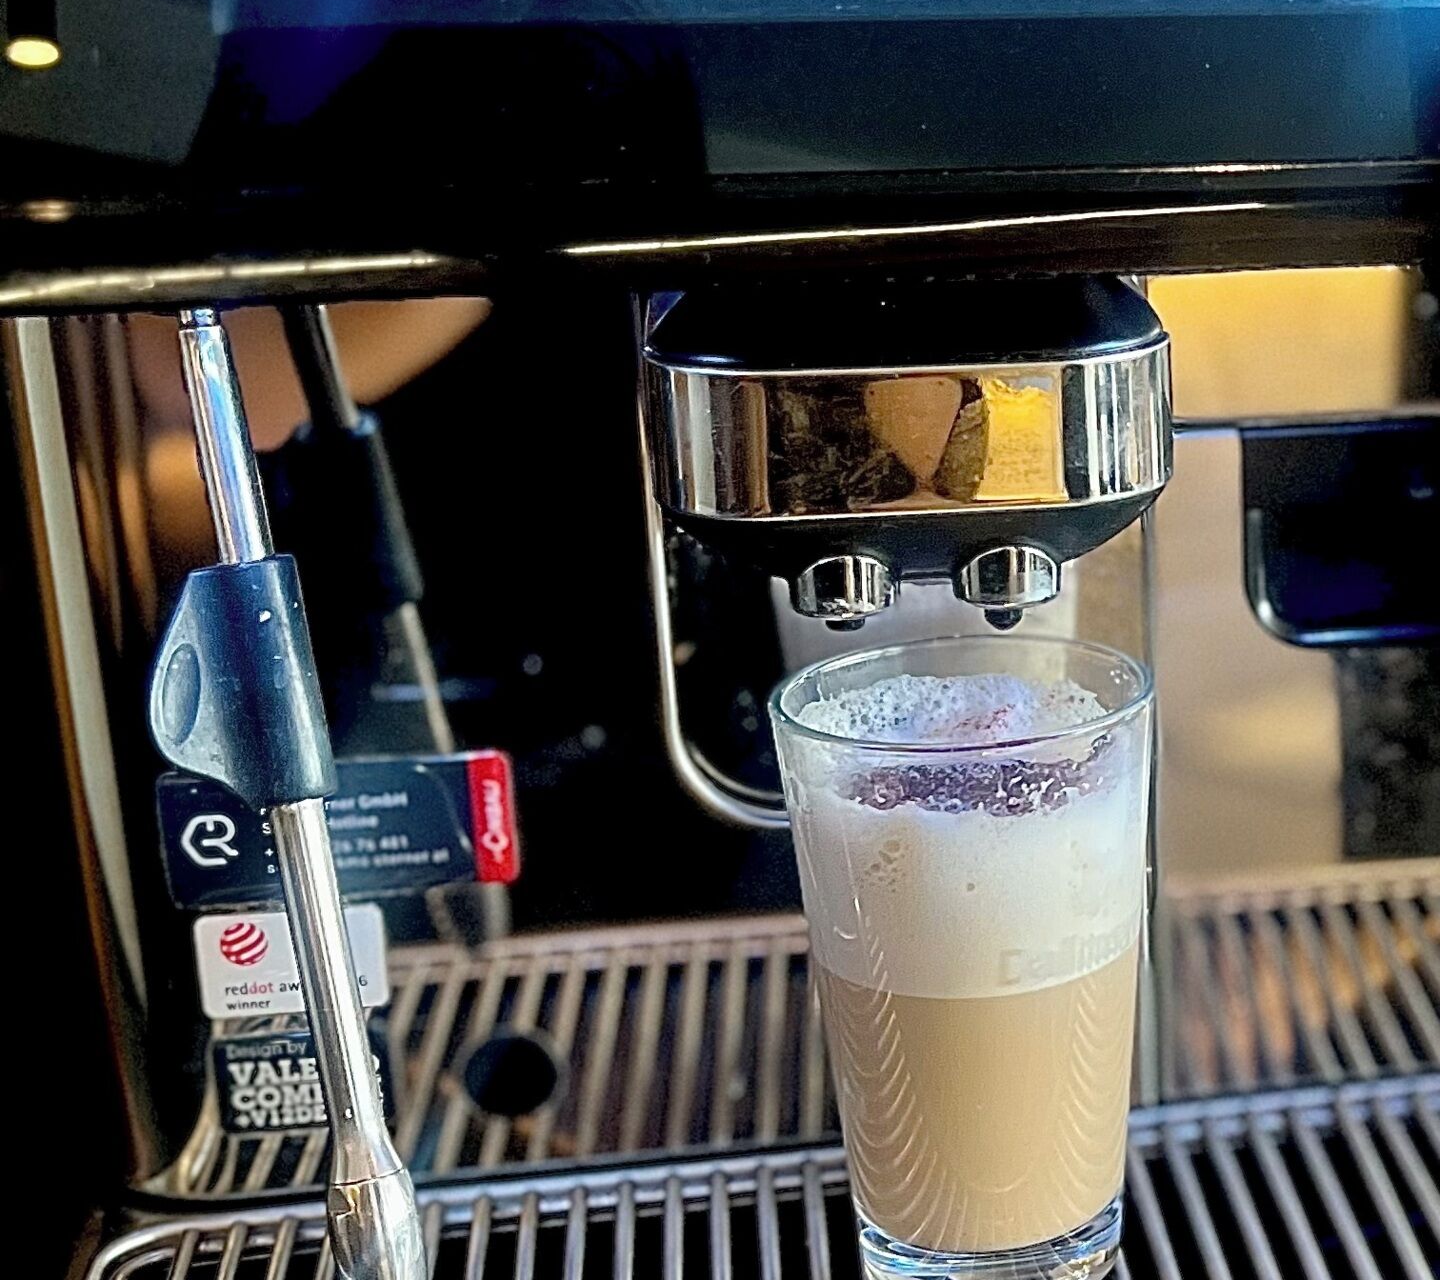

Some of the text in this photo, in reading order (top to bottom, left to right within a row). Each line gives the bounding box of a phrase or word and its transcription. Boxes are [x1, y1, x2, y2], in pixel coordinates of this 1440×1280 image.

[227, 1000, 271, 1011] winner
[226, 1041, 307, 1060] Design by
